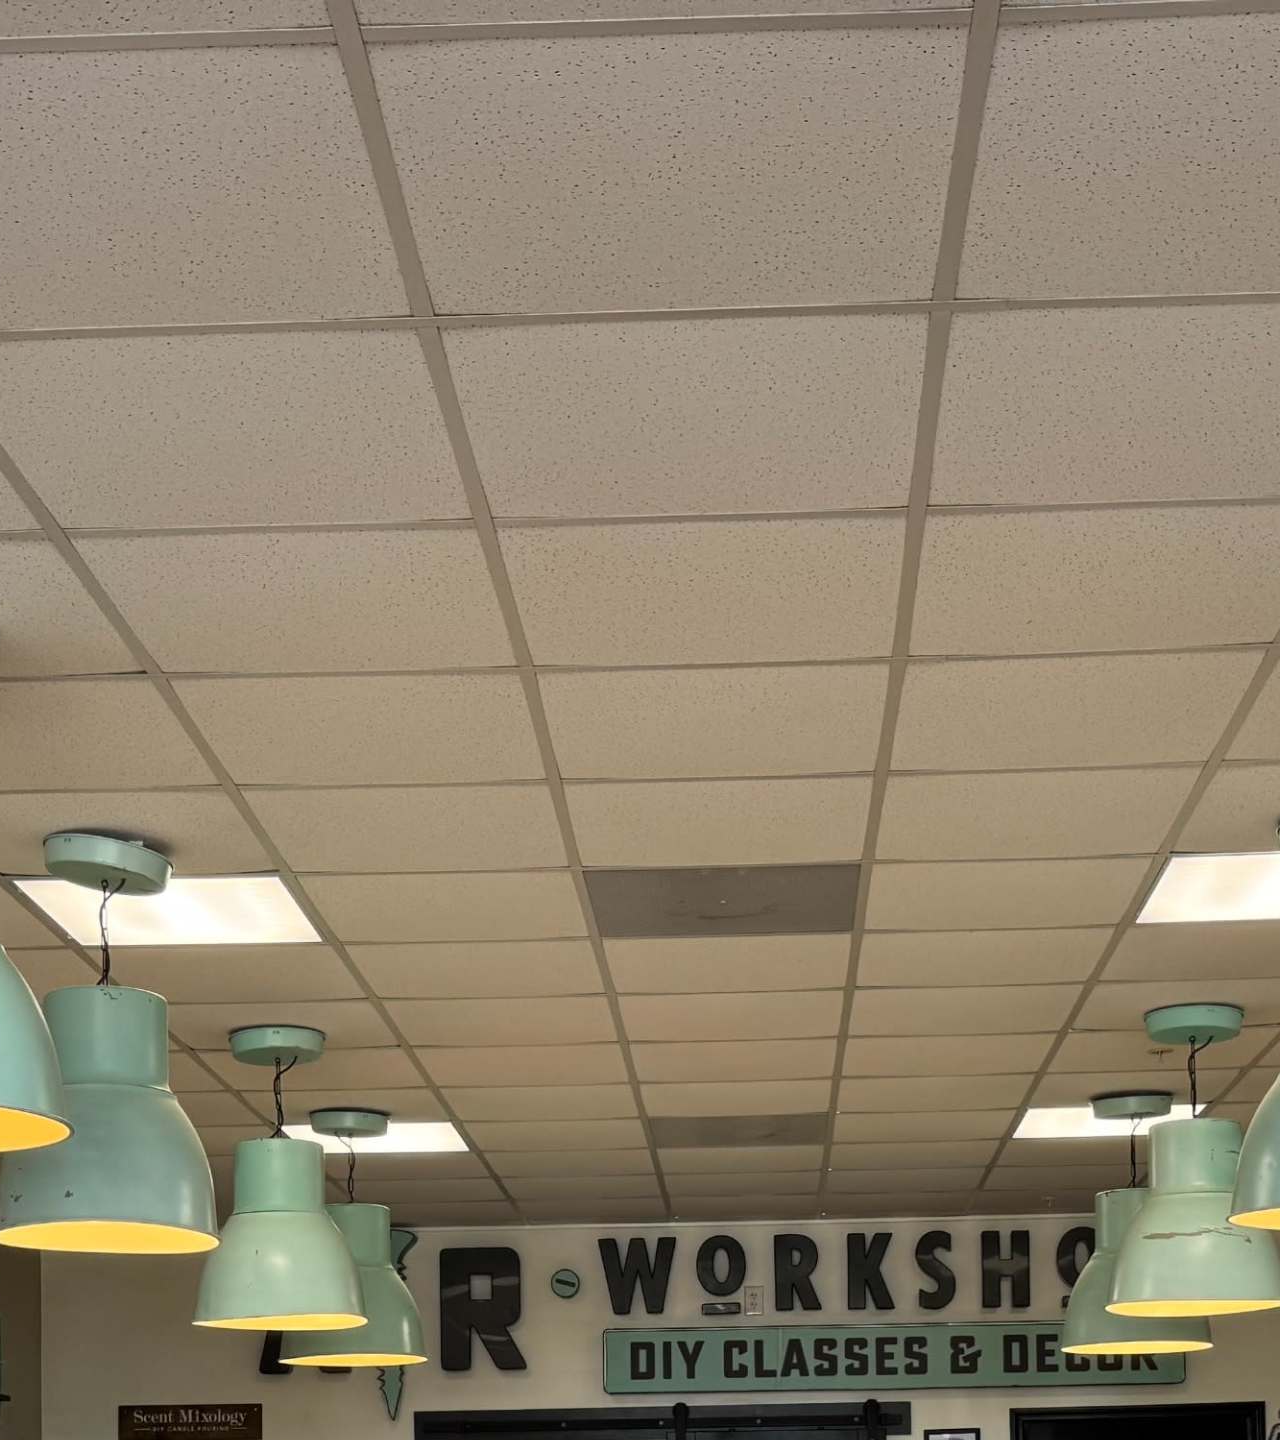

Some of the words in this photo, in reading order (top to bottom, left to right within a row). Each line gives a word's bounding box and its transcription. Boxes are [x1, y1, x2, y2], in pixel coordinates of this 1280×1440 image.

[598, 1227, 1097, 1316] WORKSHO
[629, 1340, 705, 1381] DIY
[723, 1335, 928, 1379] CLASSES
[949, 1334, 982, 1376] &
[133, 1408, 175, 1425] Scent
[179, 1408, 248, 1427] Mixology
